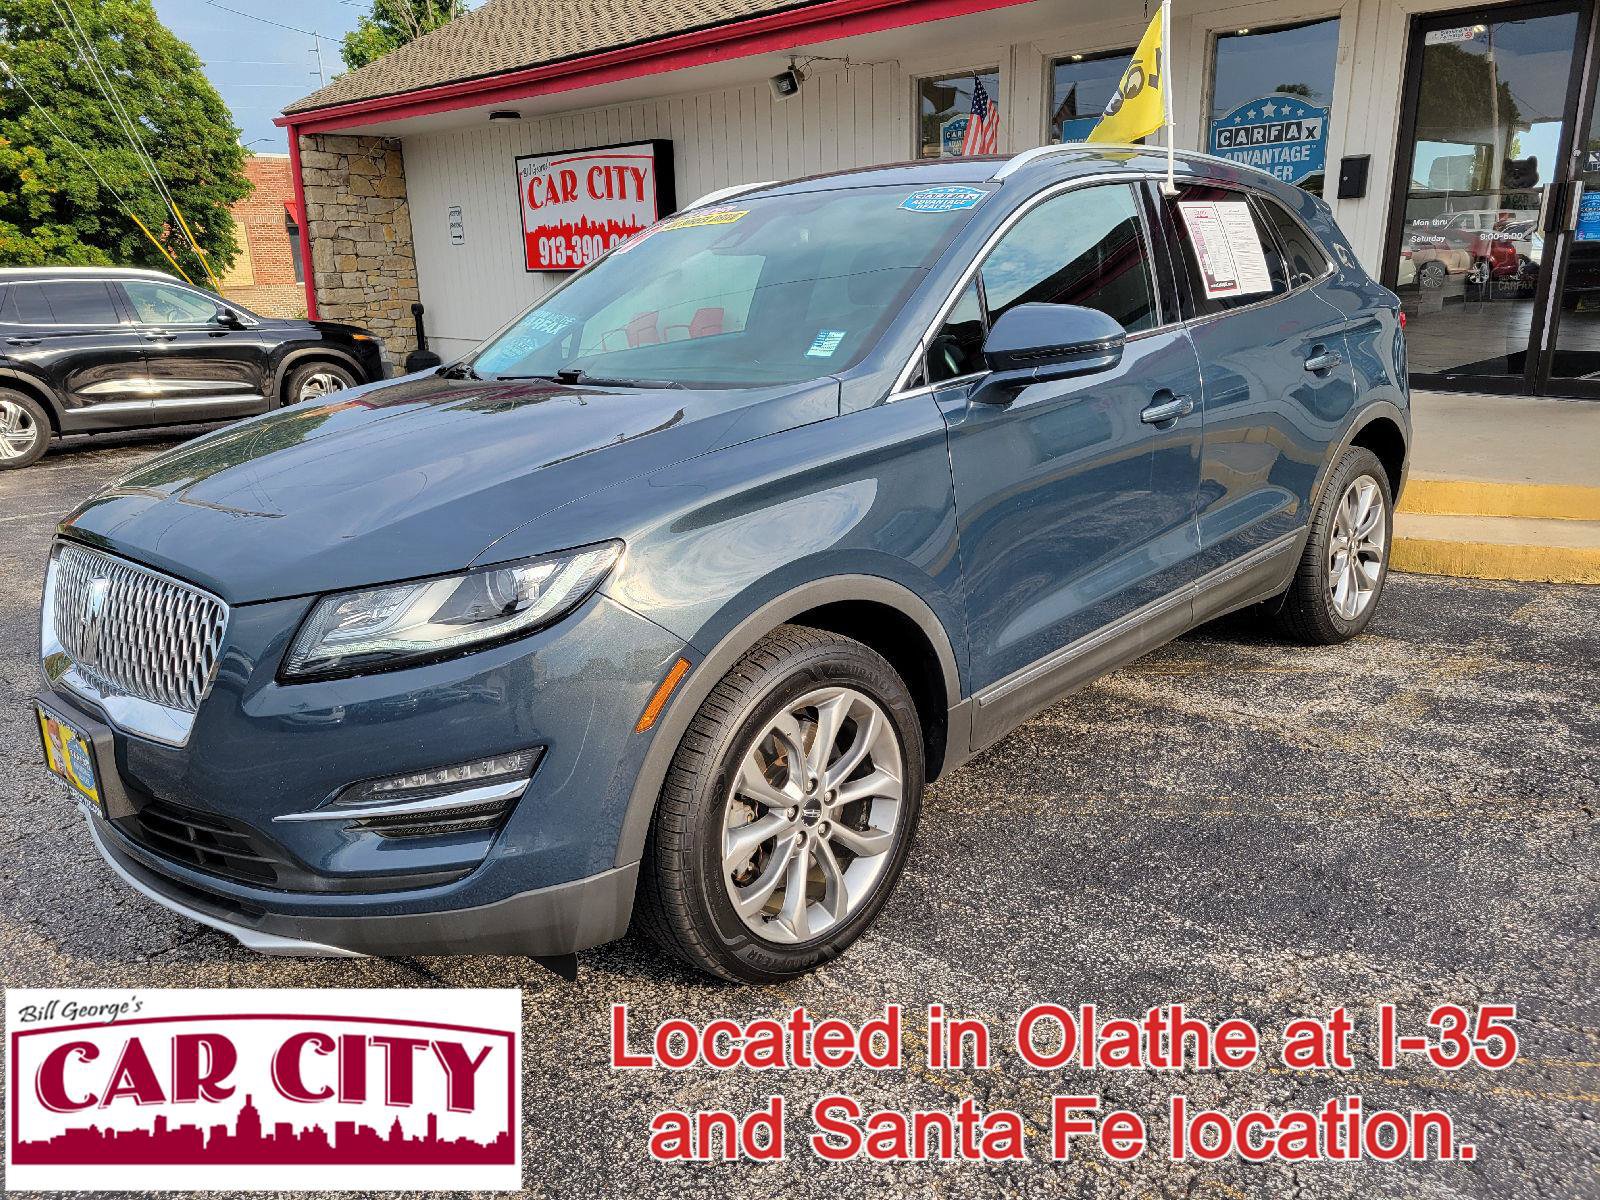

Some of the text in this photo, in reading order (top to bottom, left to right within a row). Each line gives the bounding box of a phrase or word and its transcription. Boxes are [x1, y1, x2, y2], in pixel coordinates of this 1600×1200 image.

[946, 129, 967, 139] CAR
[1219, 122, 1319, 147] CARFAX
[527, 165, 648, 210] CAR CITY
[1412, 218, 1448, 227] Mon thru
[1410, 235, 1446, 243] Saturday
